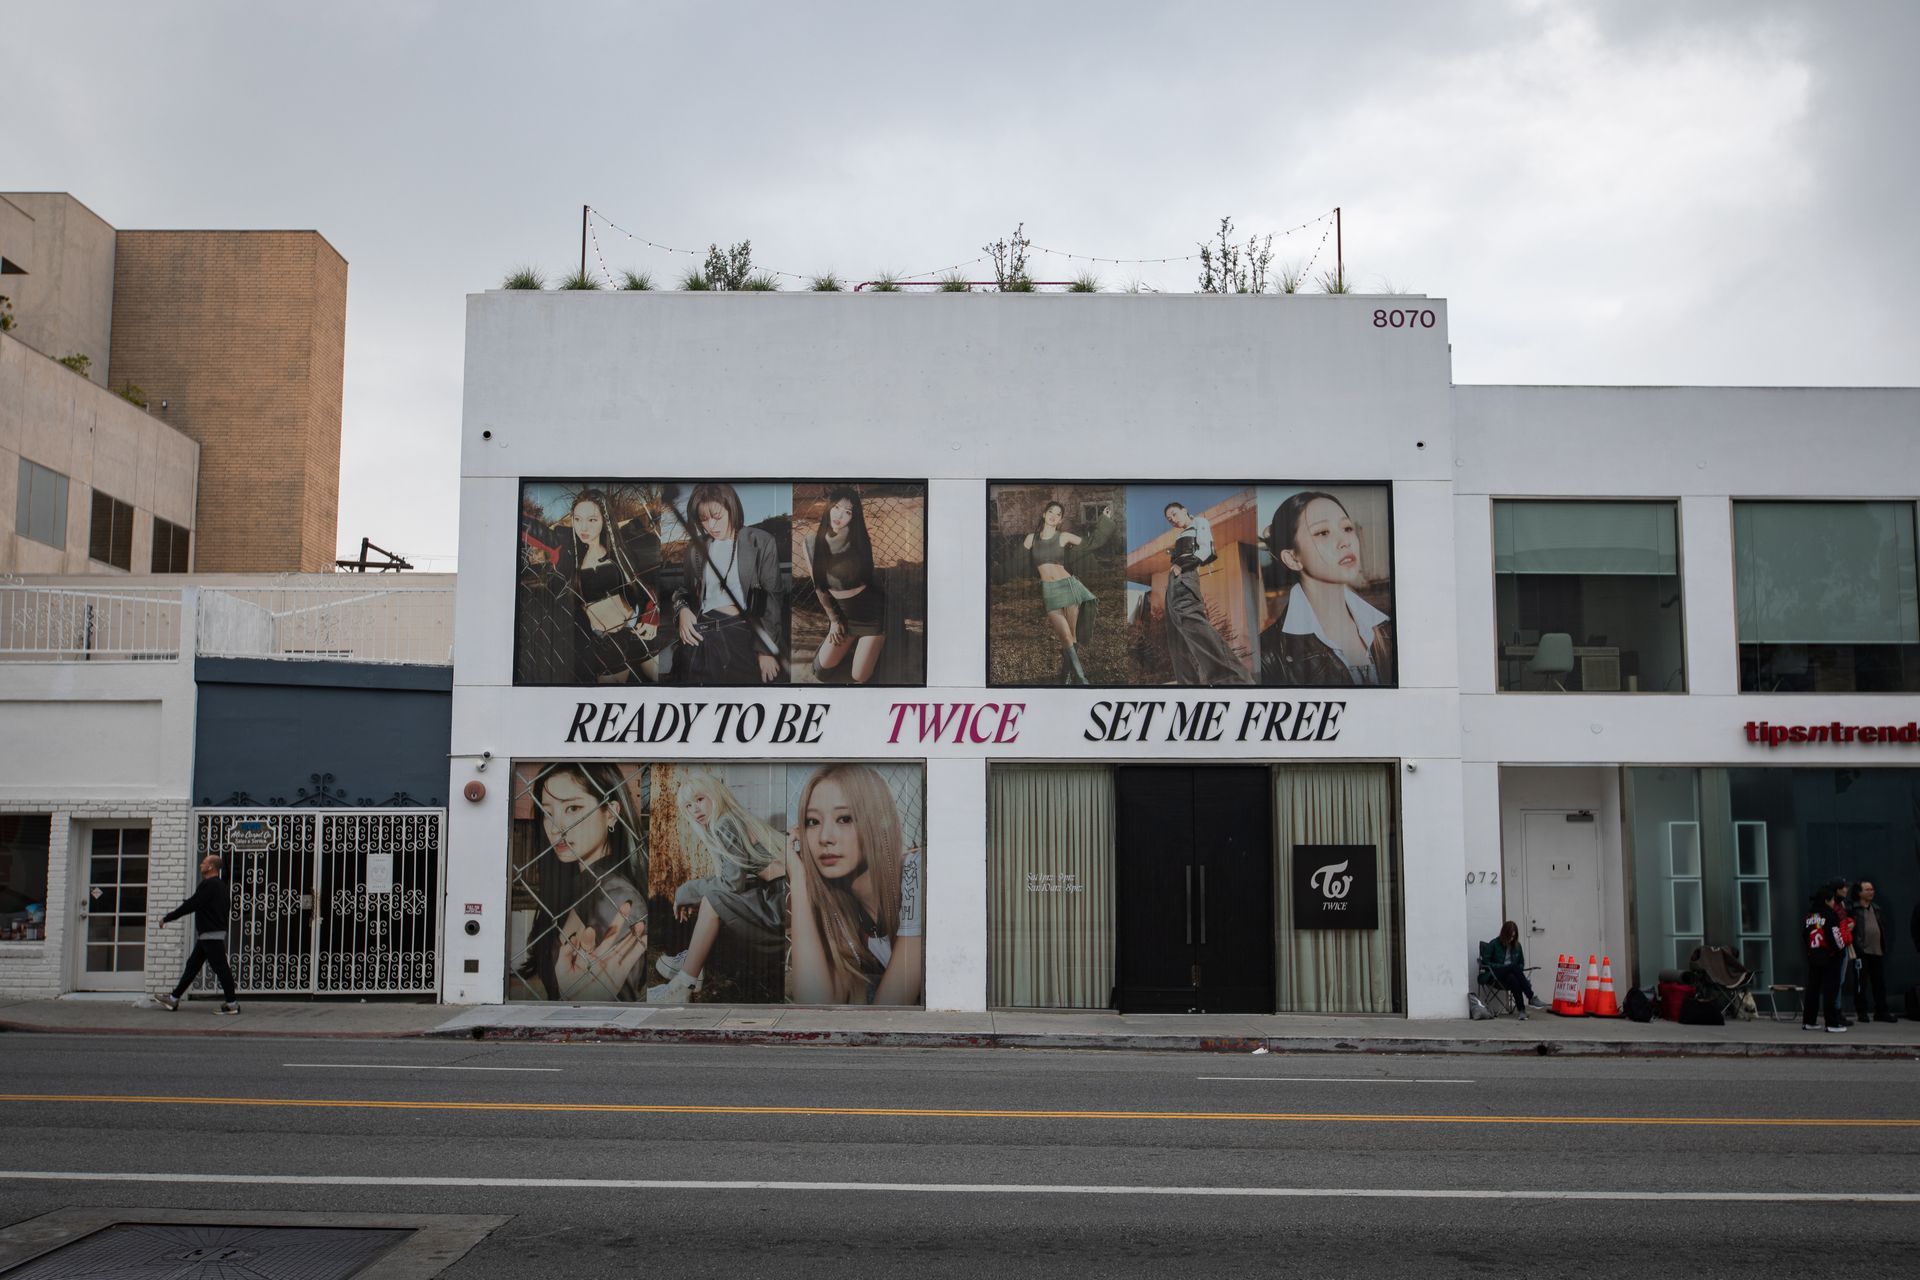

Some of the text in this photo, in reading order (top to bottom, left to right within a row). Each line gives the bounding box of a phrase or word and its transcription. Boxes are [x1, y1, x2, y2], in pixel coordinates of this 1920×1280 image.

[1373, 309, 1436, 328] 8070
[564, 702, 831, 744] READY TO BE
[887, 703, 1027, 744] TWICE
[1083, 701, 1347, 742] SET ME FREE
[1744, 721, 1920, 747] tipsntrend
[1322, 901, 1348, 911] TWICE
